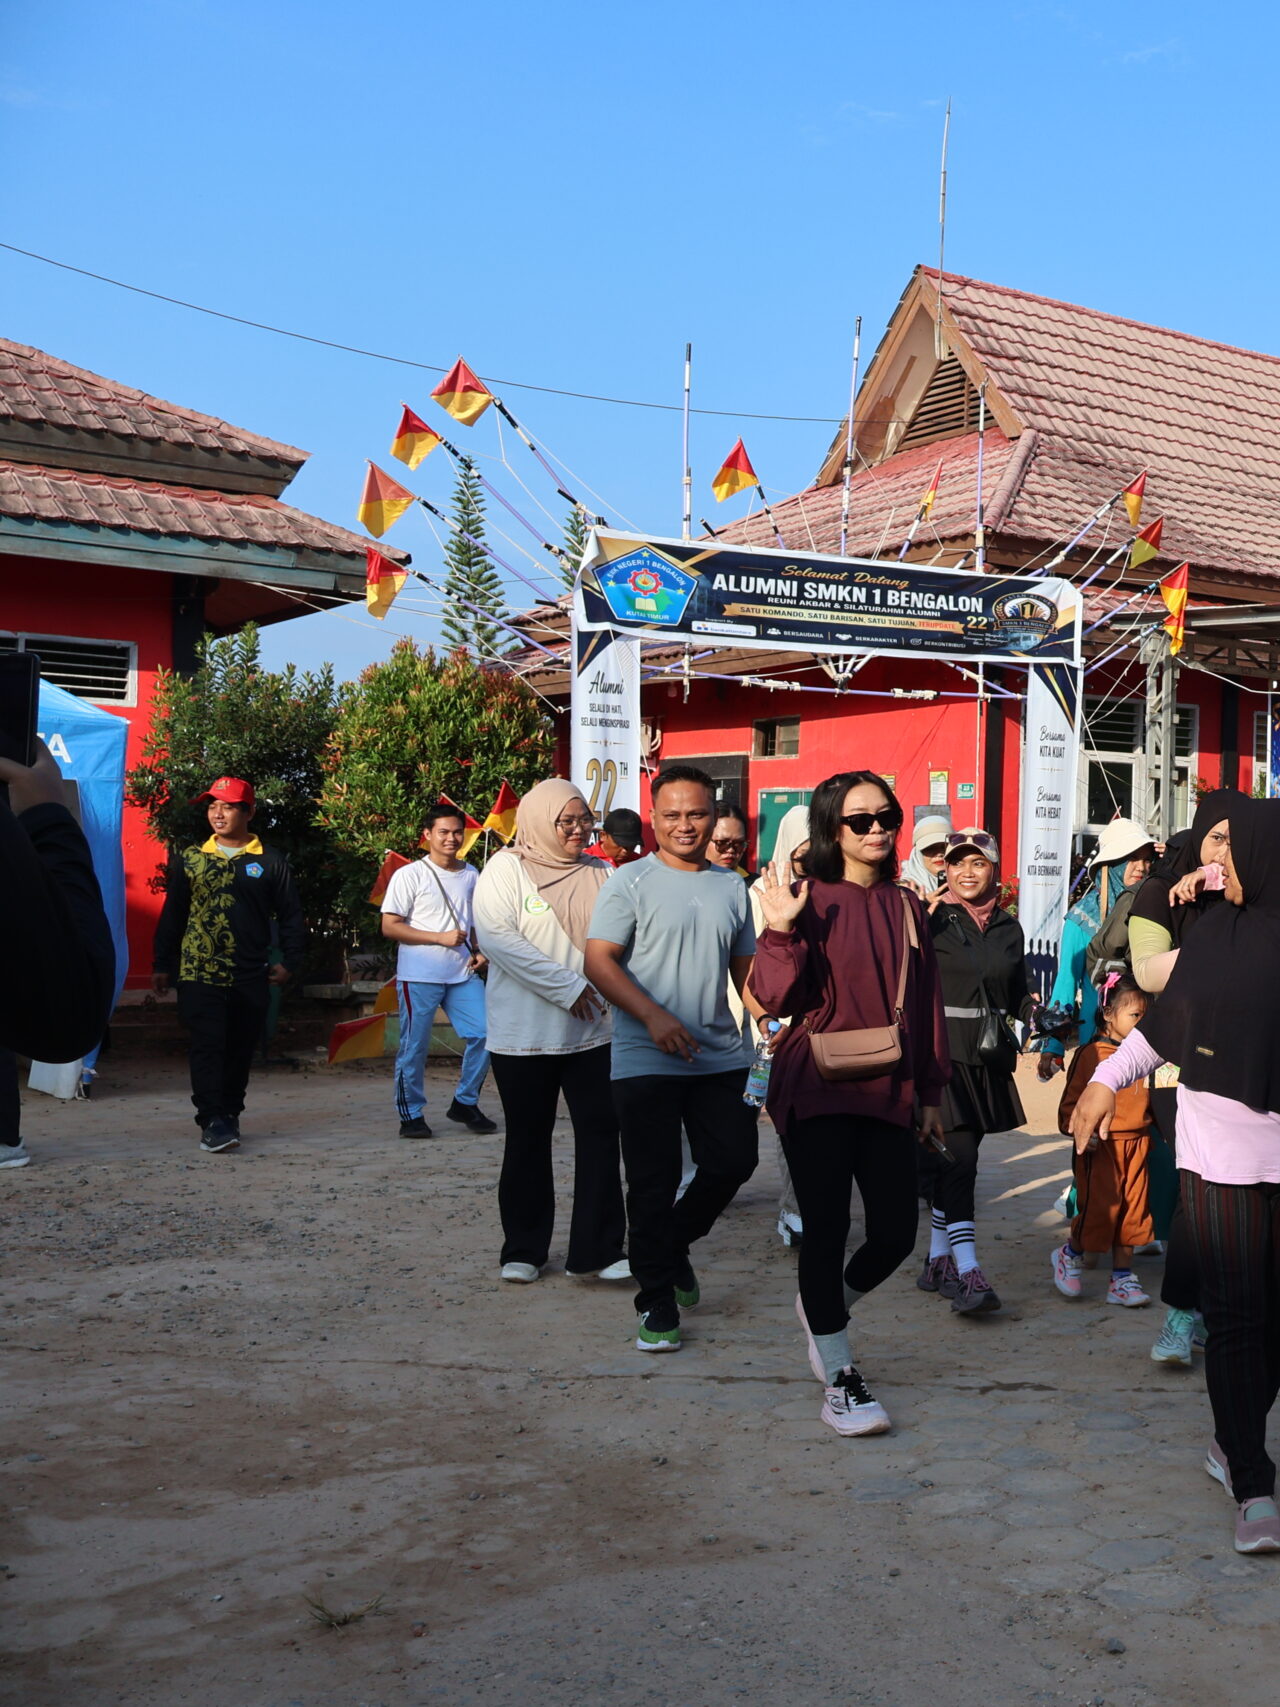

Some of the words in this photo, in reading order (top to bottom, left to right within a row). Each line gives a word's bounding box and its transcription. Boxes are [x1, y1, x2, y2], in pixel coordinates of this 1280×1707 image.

[617, 559, 645, 570] NEGERI
[652, 561, 686, 586] BENGALON
[781, 565, 849, 580] Selamat
[854, 571, 910, 590] Datang
[712, 573, 798, 597] ALUMNI
[803, 582, 866, 604] SMKN
[872, 588, 881, 605] 1
[887, 589, 983, 613] BENGALON
[767, 596, 797, 606] REUNI
[799, 599, 831, 608] AKBAR
[843, 603, 904, 615] SILATURAHMI
[906, 609, 941, 617] ALUMNI
[740, 606, 761, 614] SATU
[808, 612, 828, 620] SATU
[867, 617, 886, 625] SATU
[918, 621, 956, 630] TERUPDATE
[783, 630, 824, 639] BERSAUDARA
[855, 635, 898, 644] BERKARAKTER
[588, 670, 625, 695] Alumni
[589, 703, 605, 712] SELALU
[606, 704, 611, 713] DI
[580, 717, 598, 727] SELALU
[1039, 725, 1066, 742] Bersama
[1039, 745, 1051, 758] KITA
[1052, 746, 1065, 759] KUAT
[1036, 786, 1062, 802] Bersama
[1035, 806, 1047, 818] KITA
[1047, 807, 1061, 819] HEBAT
[1034, 844, 1058, 861] Bersama
[1027, 864, 1037, 875] KITA
